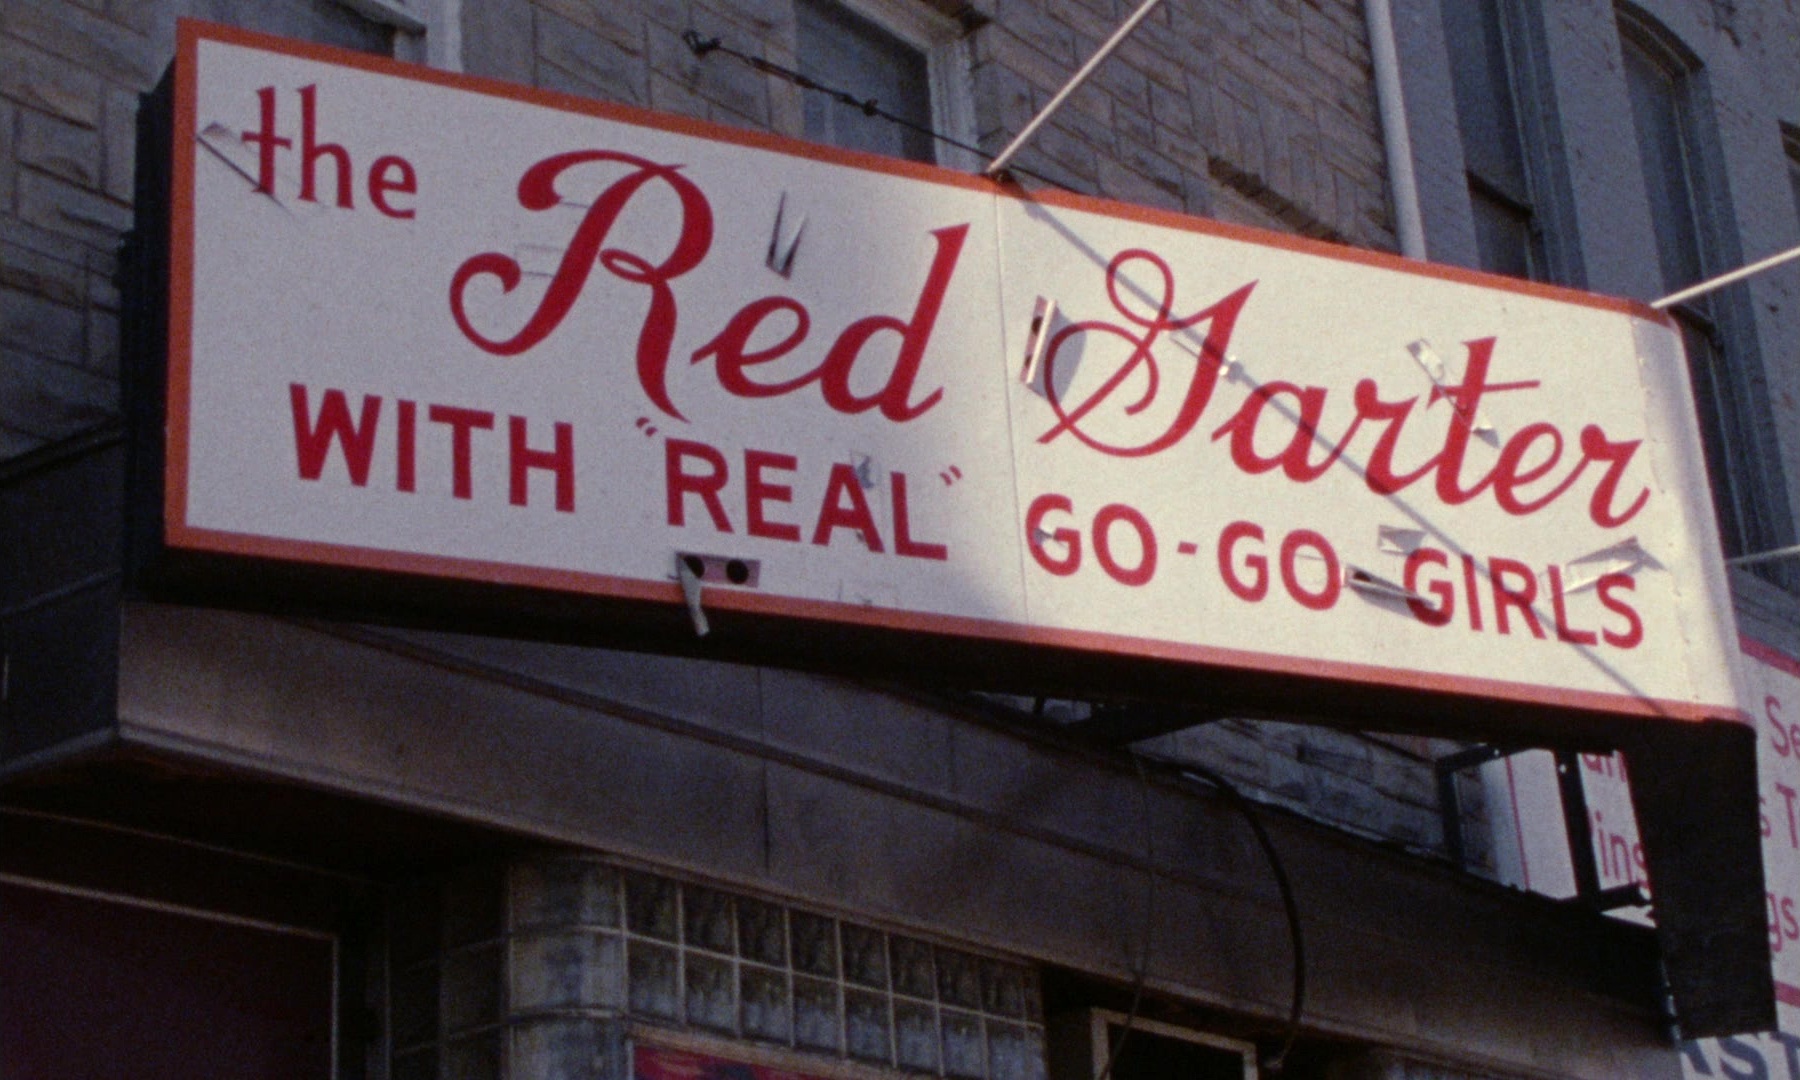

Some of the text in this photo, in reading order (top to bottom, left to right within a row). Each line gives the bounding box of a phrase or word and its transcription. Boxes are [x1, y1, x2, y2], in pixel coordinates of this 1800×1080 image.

[241, 83, 418, 220] the
[448, 148, 1651, 529] Red Garter
[288, 382, 1644, 650] WITH "REAL" GO-GO GIRLS
